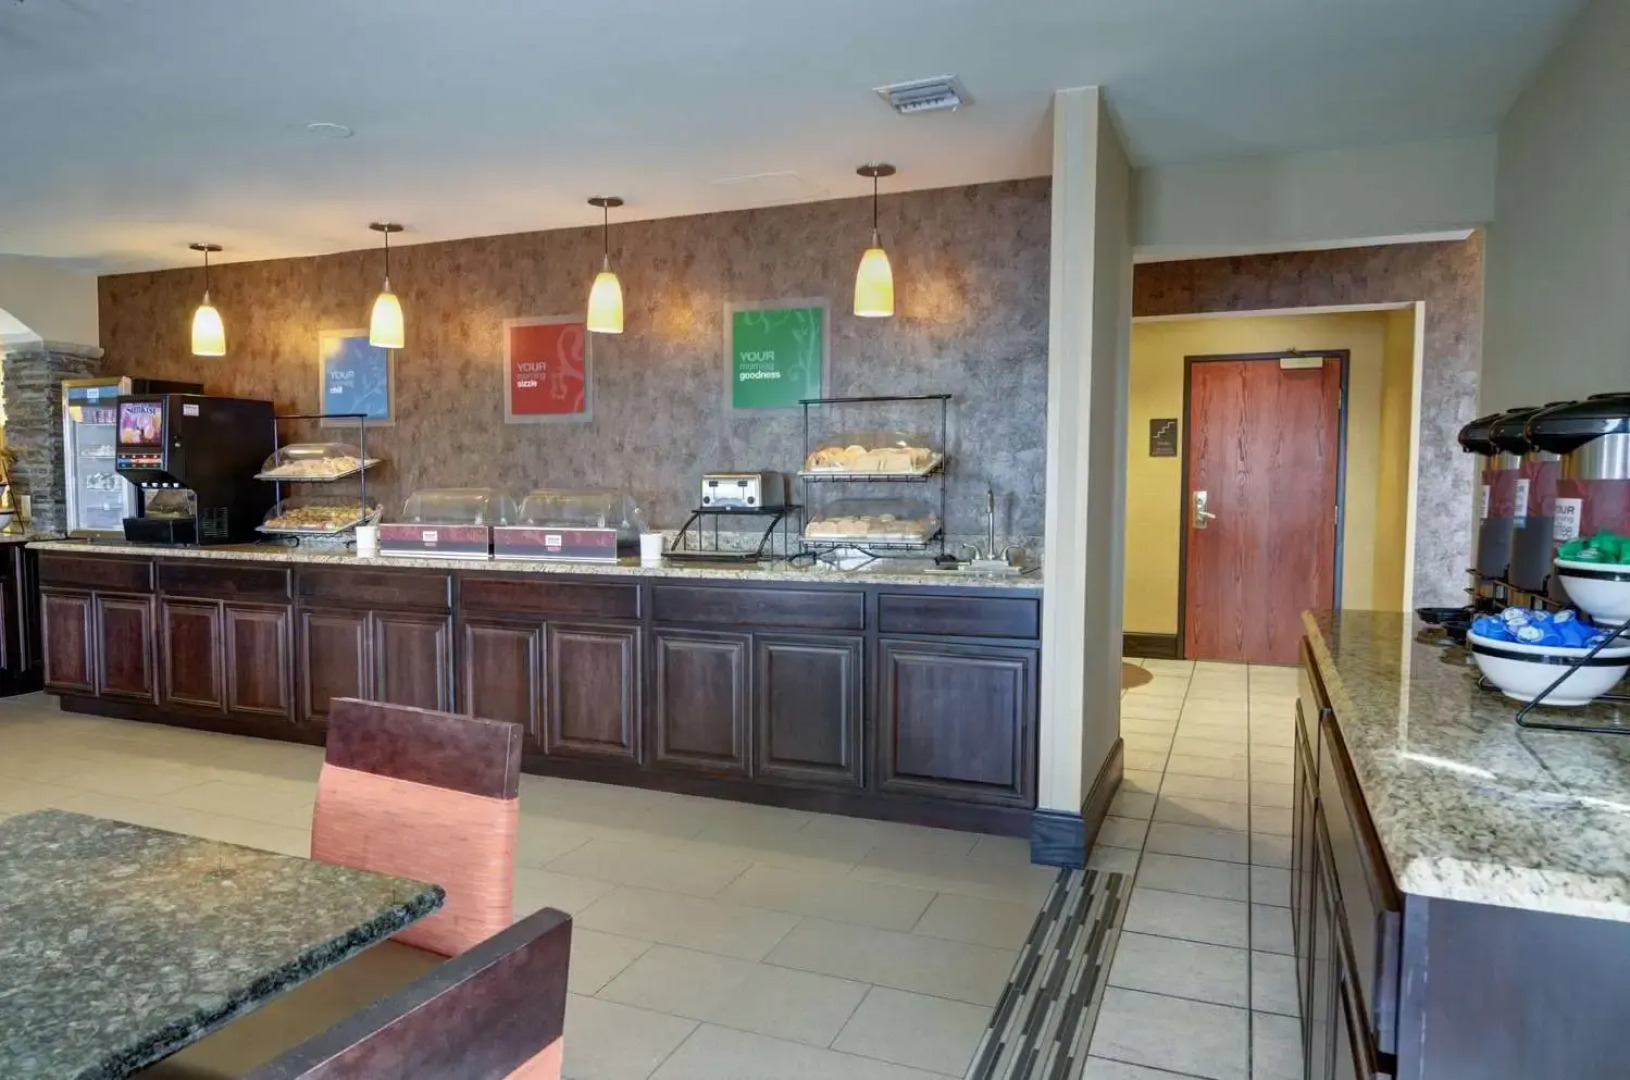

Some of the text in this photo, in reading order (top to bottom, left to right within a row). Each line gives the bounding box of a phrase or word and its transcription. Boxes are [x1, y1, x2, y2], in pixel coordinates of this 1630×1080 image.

[740, 350, 775, 362] YOUR
[517, 361, 547, 372] YOUR
[330, 370, 355, 380] YOUR
[739, 369, 782, 382] goodness
[517, 379, 538, 388] sizzle
[1555, 505, 1575, 515] OUR
